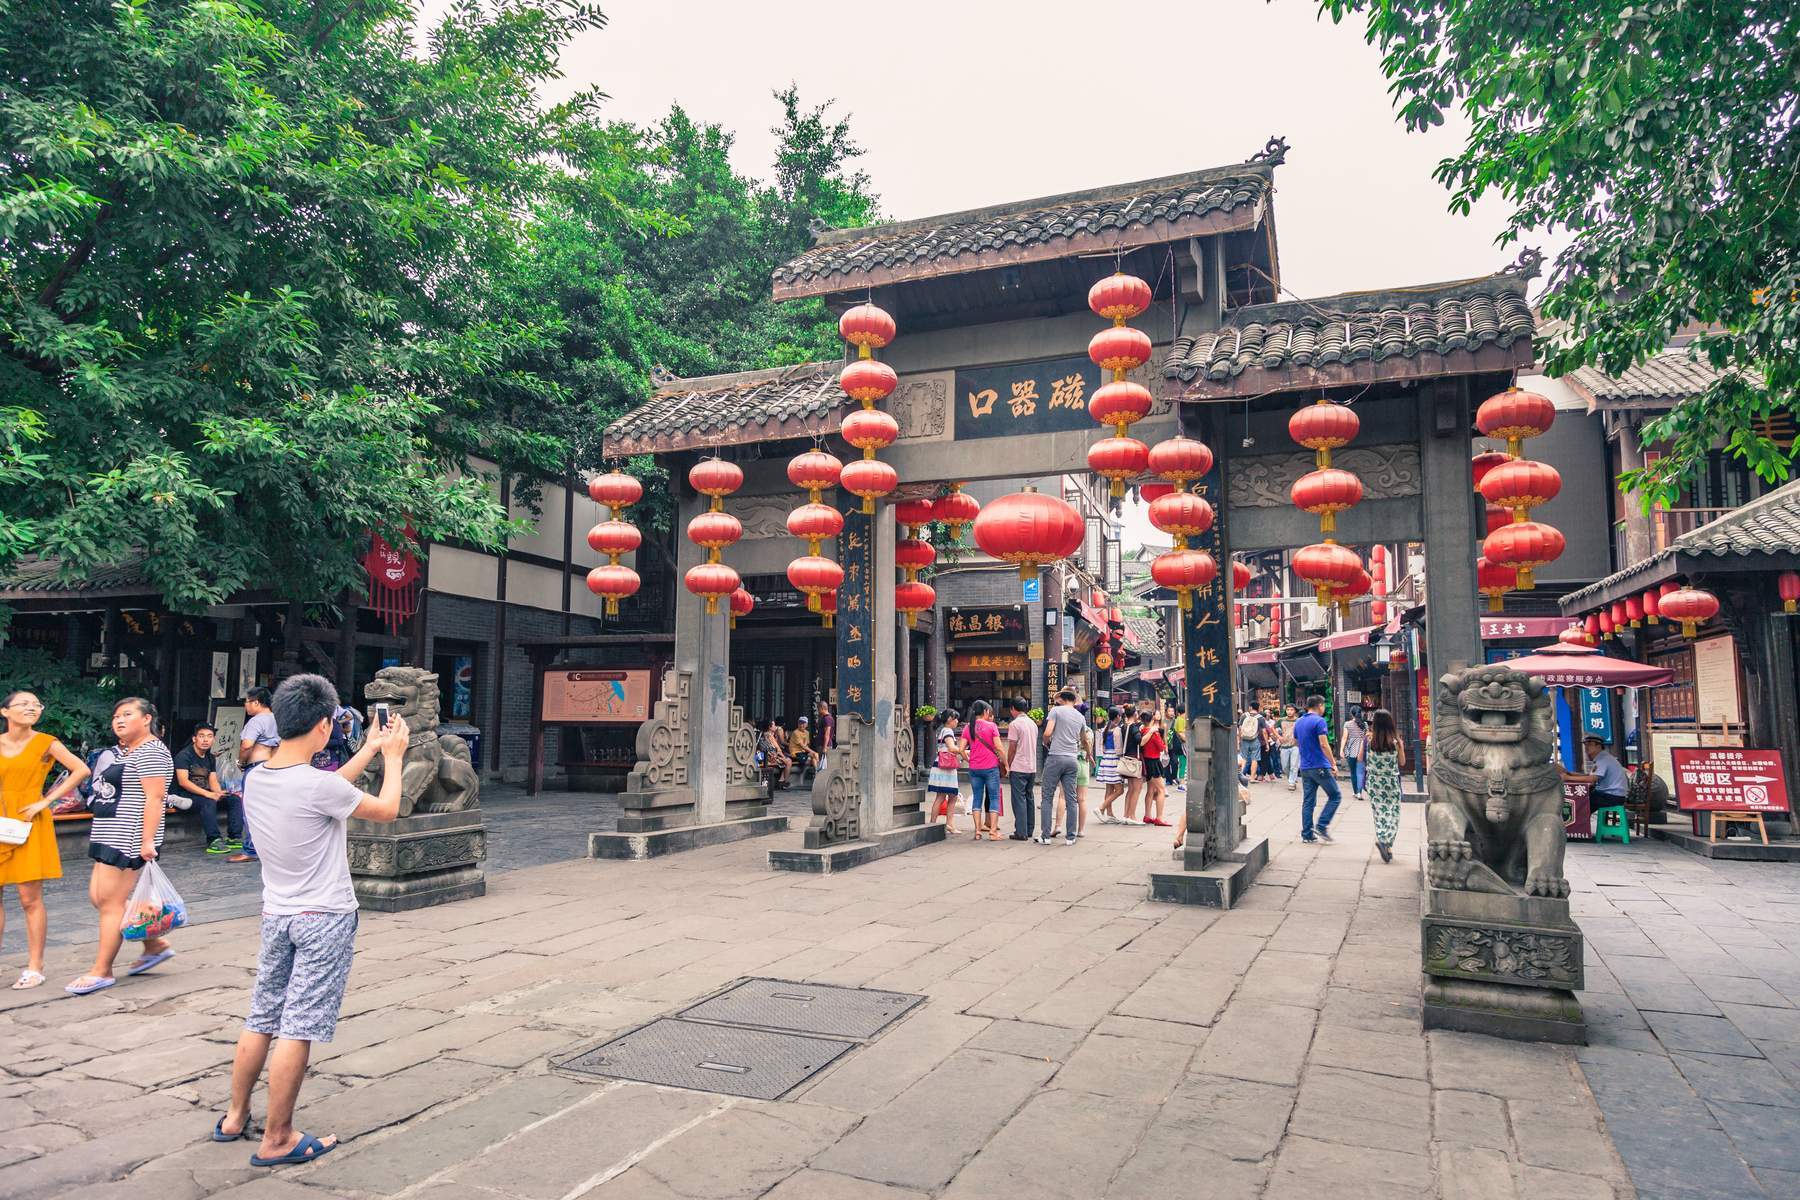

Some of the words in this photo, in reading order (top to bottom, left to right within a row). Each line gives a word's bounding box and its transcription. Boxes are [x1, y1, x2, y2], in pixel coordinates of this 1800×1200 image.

[1488, 622, 1527, 636] 王老吉
[1682, 772, 1732, 785] 吸烟区
